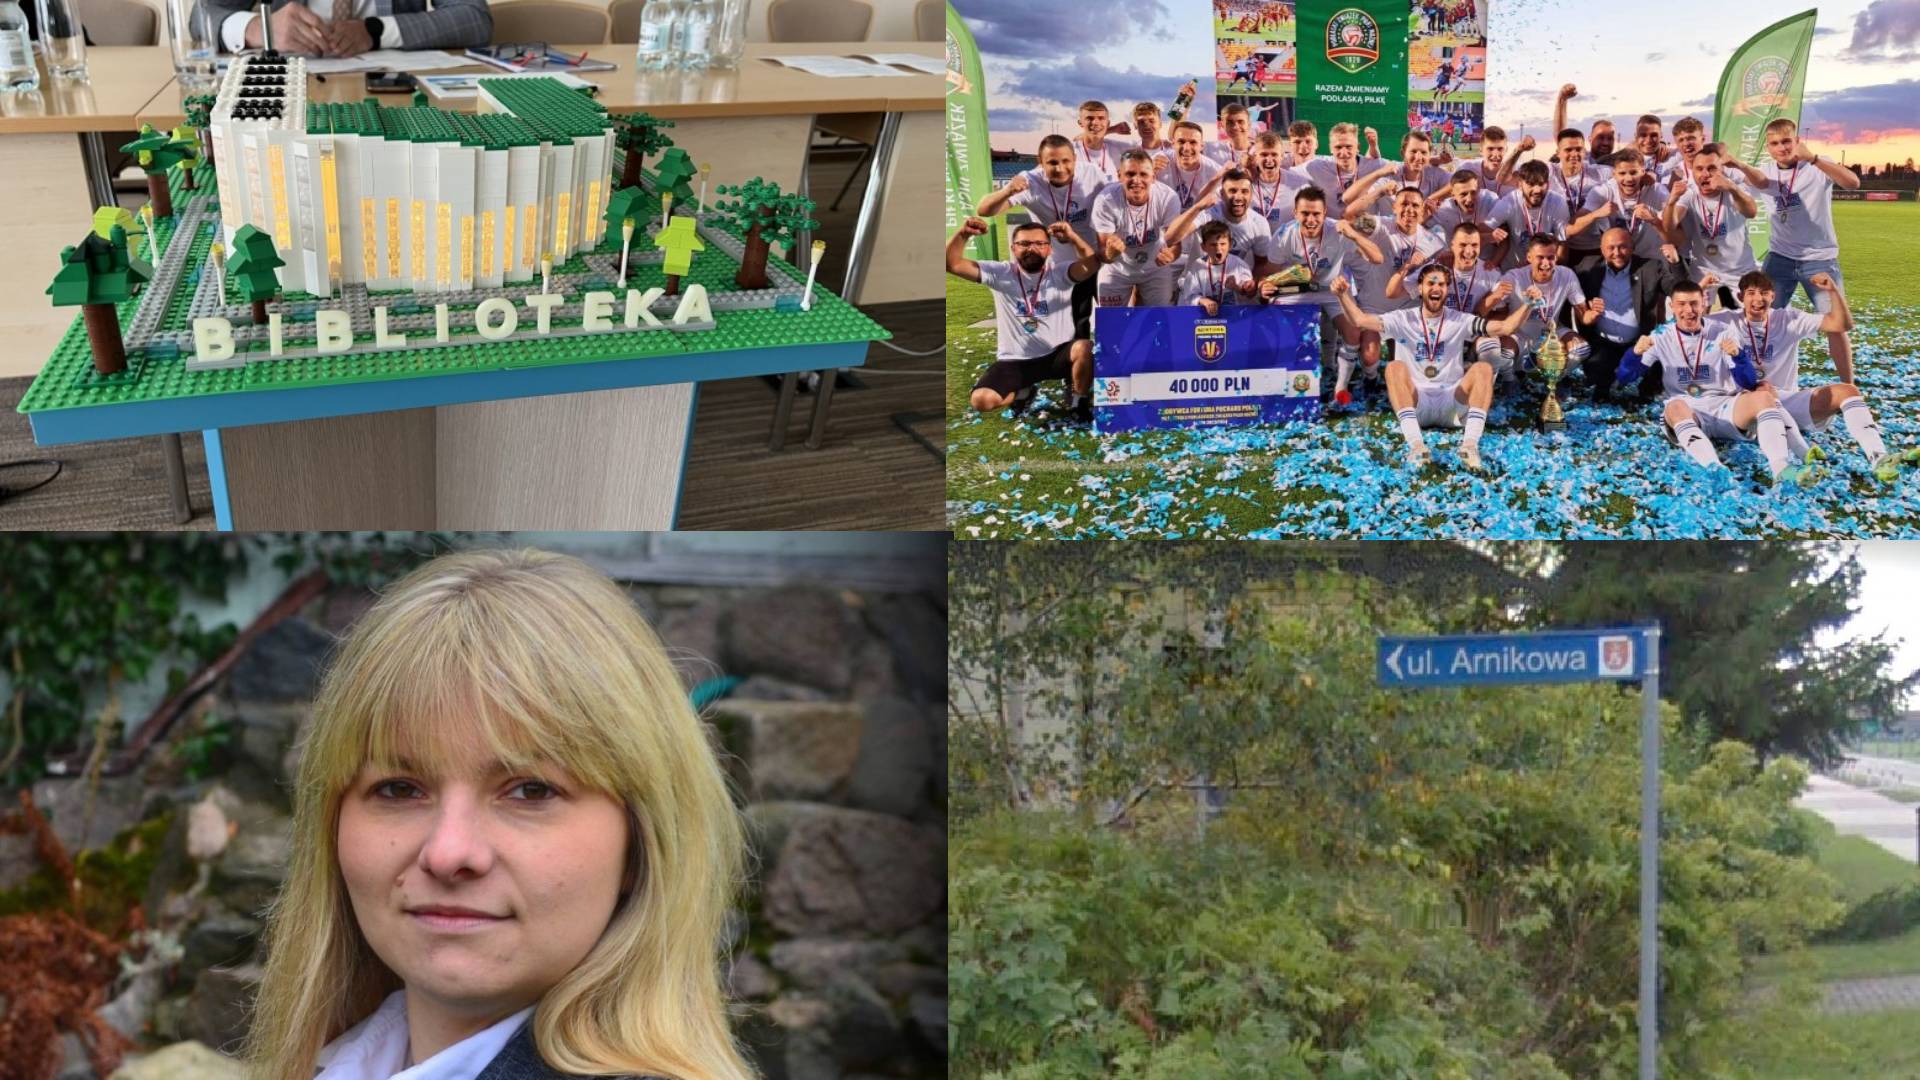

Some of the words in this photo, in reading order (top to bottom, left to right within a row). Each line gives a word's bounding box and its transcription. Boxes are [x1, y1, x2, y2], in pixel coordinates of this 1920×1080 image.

[1315, 84, 1343, 92] RAZEM
[1345, 85, 1390, 94] ZMIENIAMY
[193, 284, 713, 363] BIBLIOTEKA
[1169, 379, 1188, 393] 40
[1191, 378, 1219, 393] 000
[1224, 376, 1250, 392] PLN
[1407, 648, 1440, 675] ul.
[1450, 646, 1586, 674] Arnikowa
